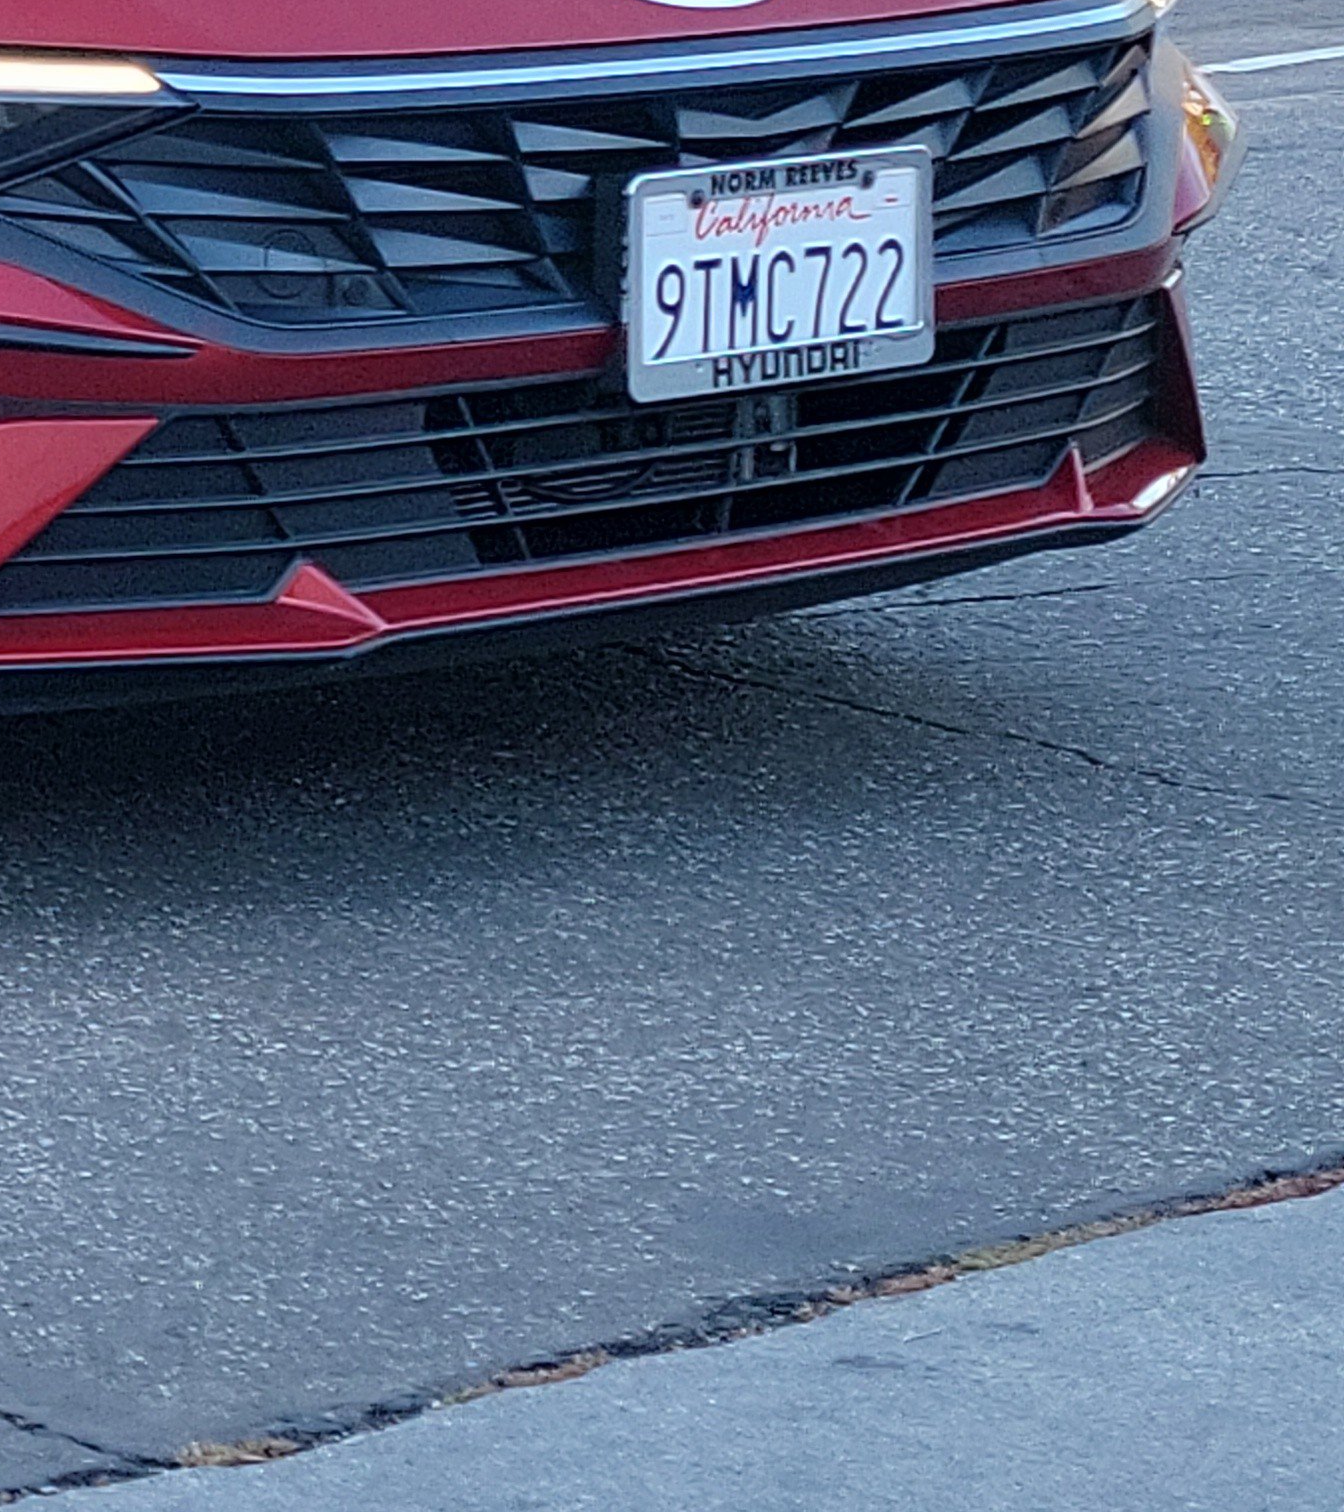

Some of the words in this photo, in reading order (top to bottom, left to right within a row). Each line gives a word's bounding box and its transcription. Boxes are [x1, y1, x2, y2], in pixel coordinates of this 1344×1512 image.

[710, 169, 776, 196] NORM
[785, 160, 858, 187] REEVES
[694, 193, 872, 249] California
[652, 238, 905, 361] 9TMC722
[713, 342, 862, 389] HYUNDAI
